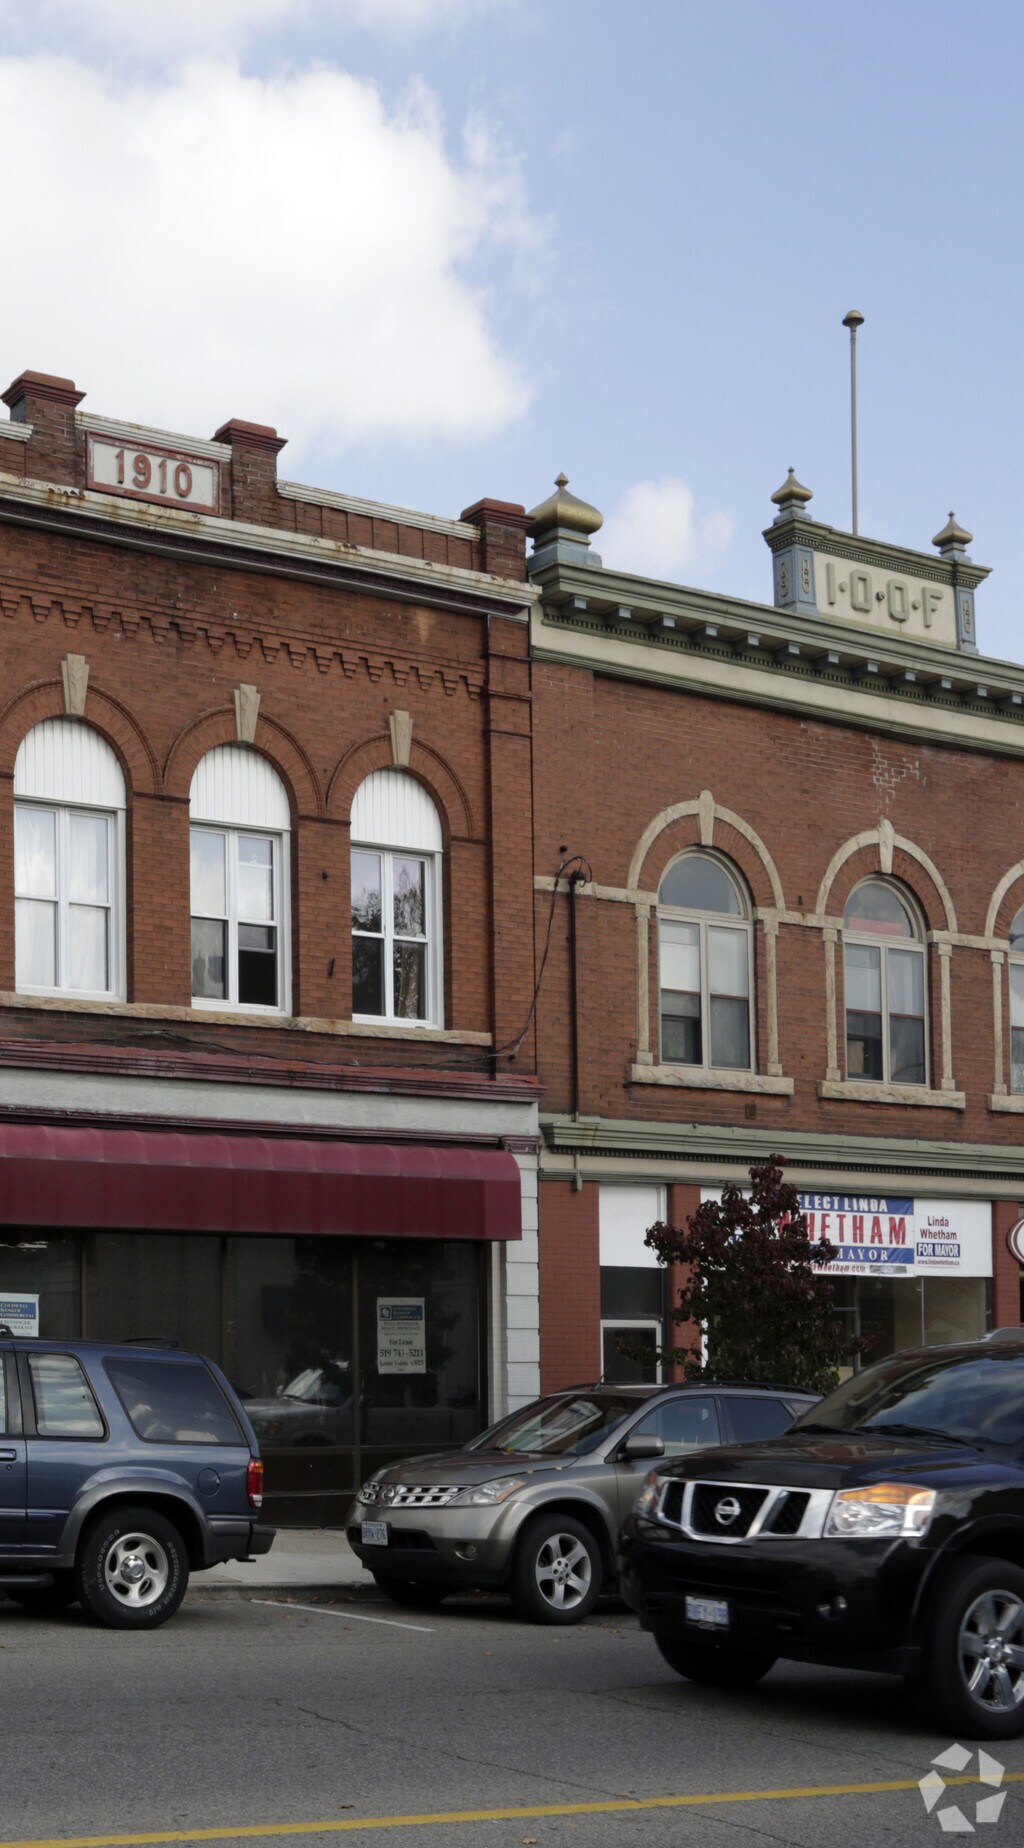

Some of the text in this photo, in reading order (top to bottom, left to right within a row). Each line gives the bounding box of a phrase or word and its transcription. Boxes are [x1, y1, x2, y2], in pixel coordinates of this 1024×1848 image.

[116, 448, 193, 498] 1910
[843, 1197, 888, 1213] LINDA
[927, 1216, 949, 1227] Linda
[920, 1228, 957, 1240] Whetham
[918, 1244, 959, 1256] FOR MAYOR
